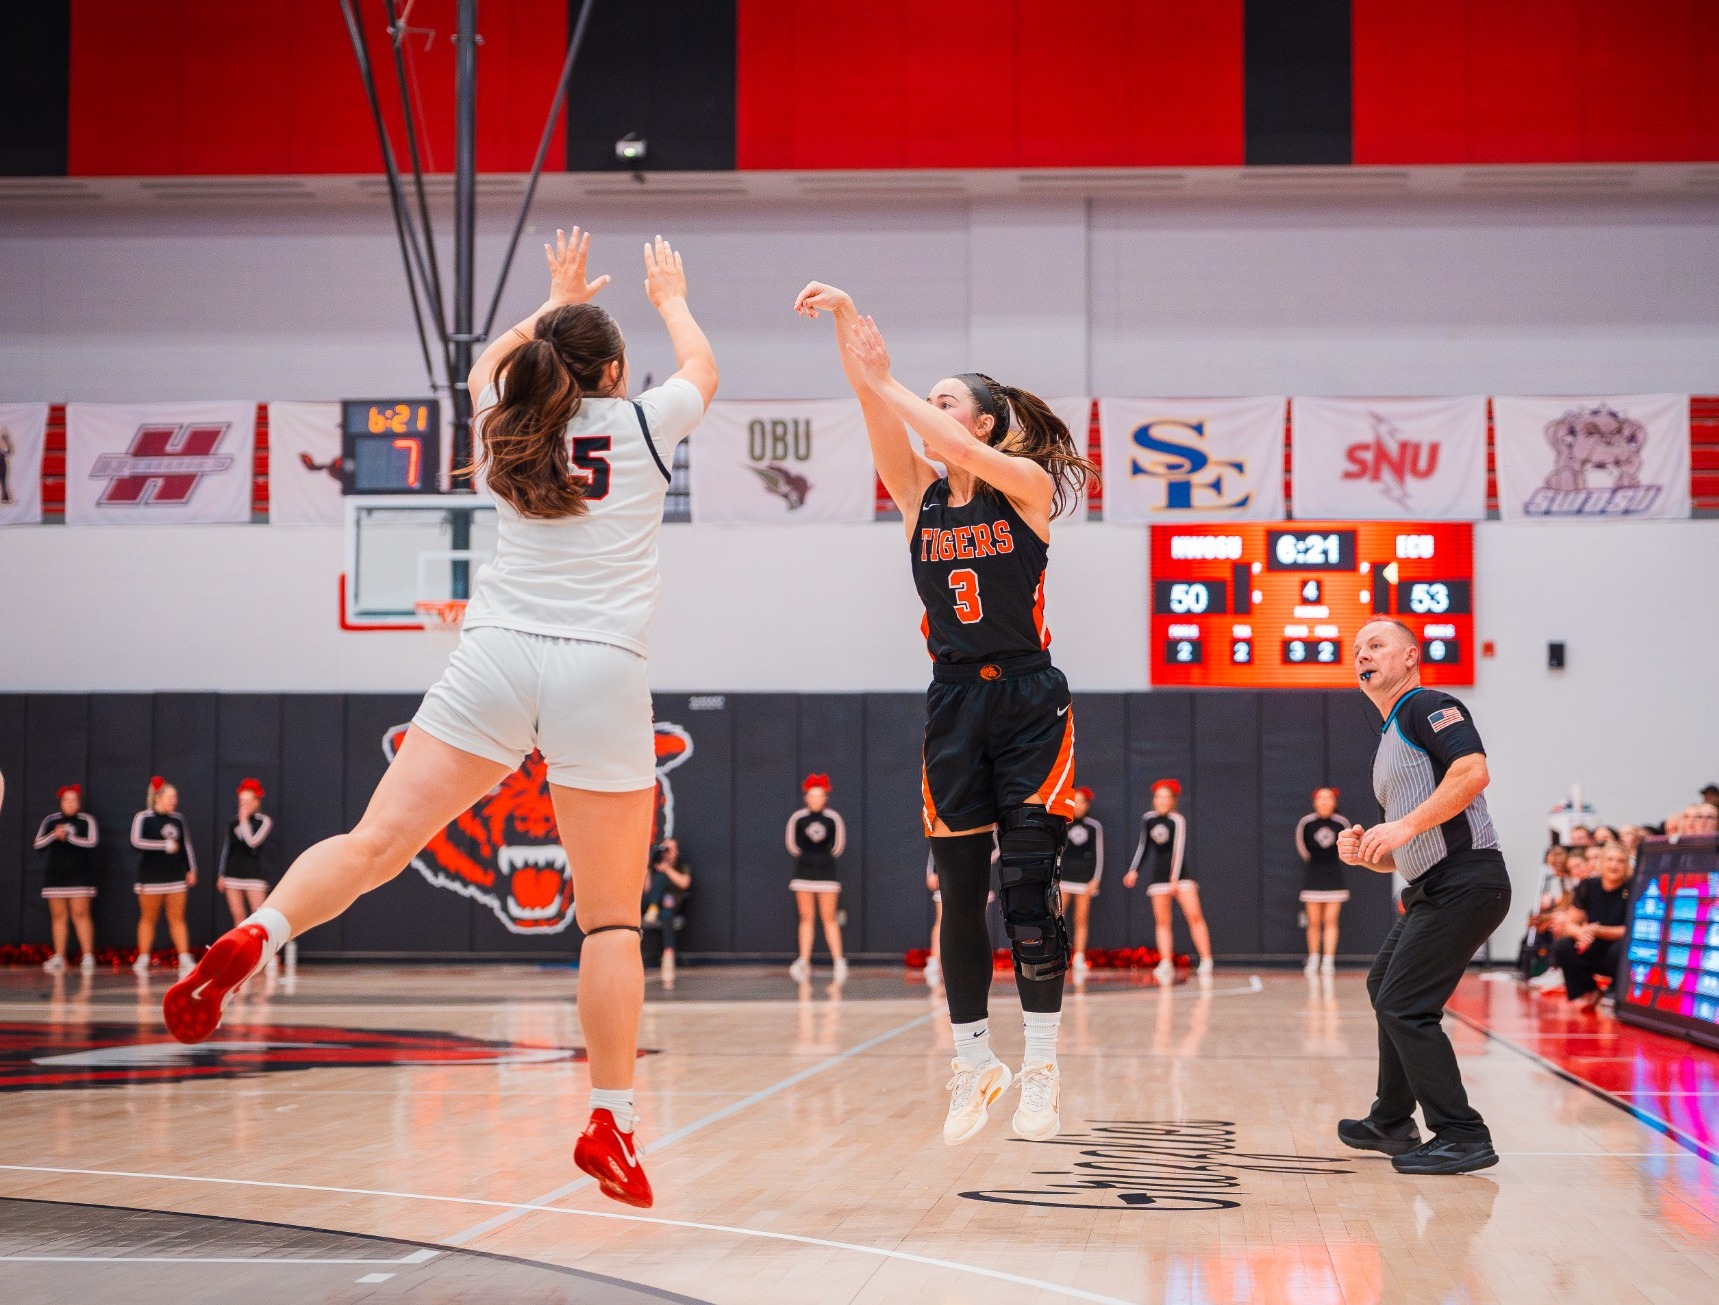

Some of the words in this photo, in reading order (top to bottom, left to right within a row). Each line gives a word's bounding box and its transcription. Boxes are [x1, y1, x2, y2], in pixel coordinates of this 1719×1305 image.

[368, 404, 428, 434] 6:21
[747, 418, 812, 462] OBU
[392, 438, 421, 487] 7
[569, 435, 611, 501] 5
[1342, 440, 1441, 482] SNU
[920, 519, 1014, 562] TIGERS
[1275, 533, 1341, 565] 6:21
[948, 568, 984, 624] 3
[1169, 583, 1209, 614] 50
[1301, 579, 1319, 600] 4
[1409, 582, 1450, 614] 53
[1176, 641, 1193, 662] 2
[1233, 641, 1250, 662] 2
[1289, 640, 1306, 662] 3
[1317, 641, 1335, 662] 2
